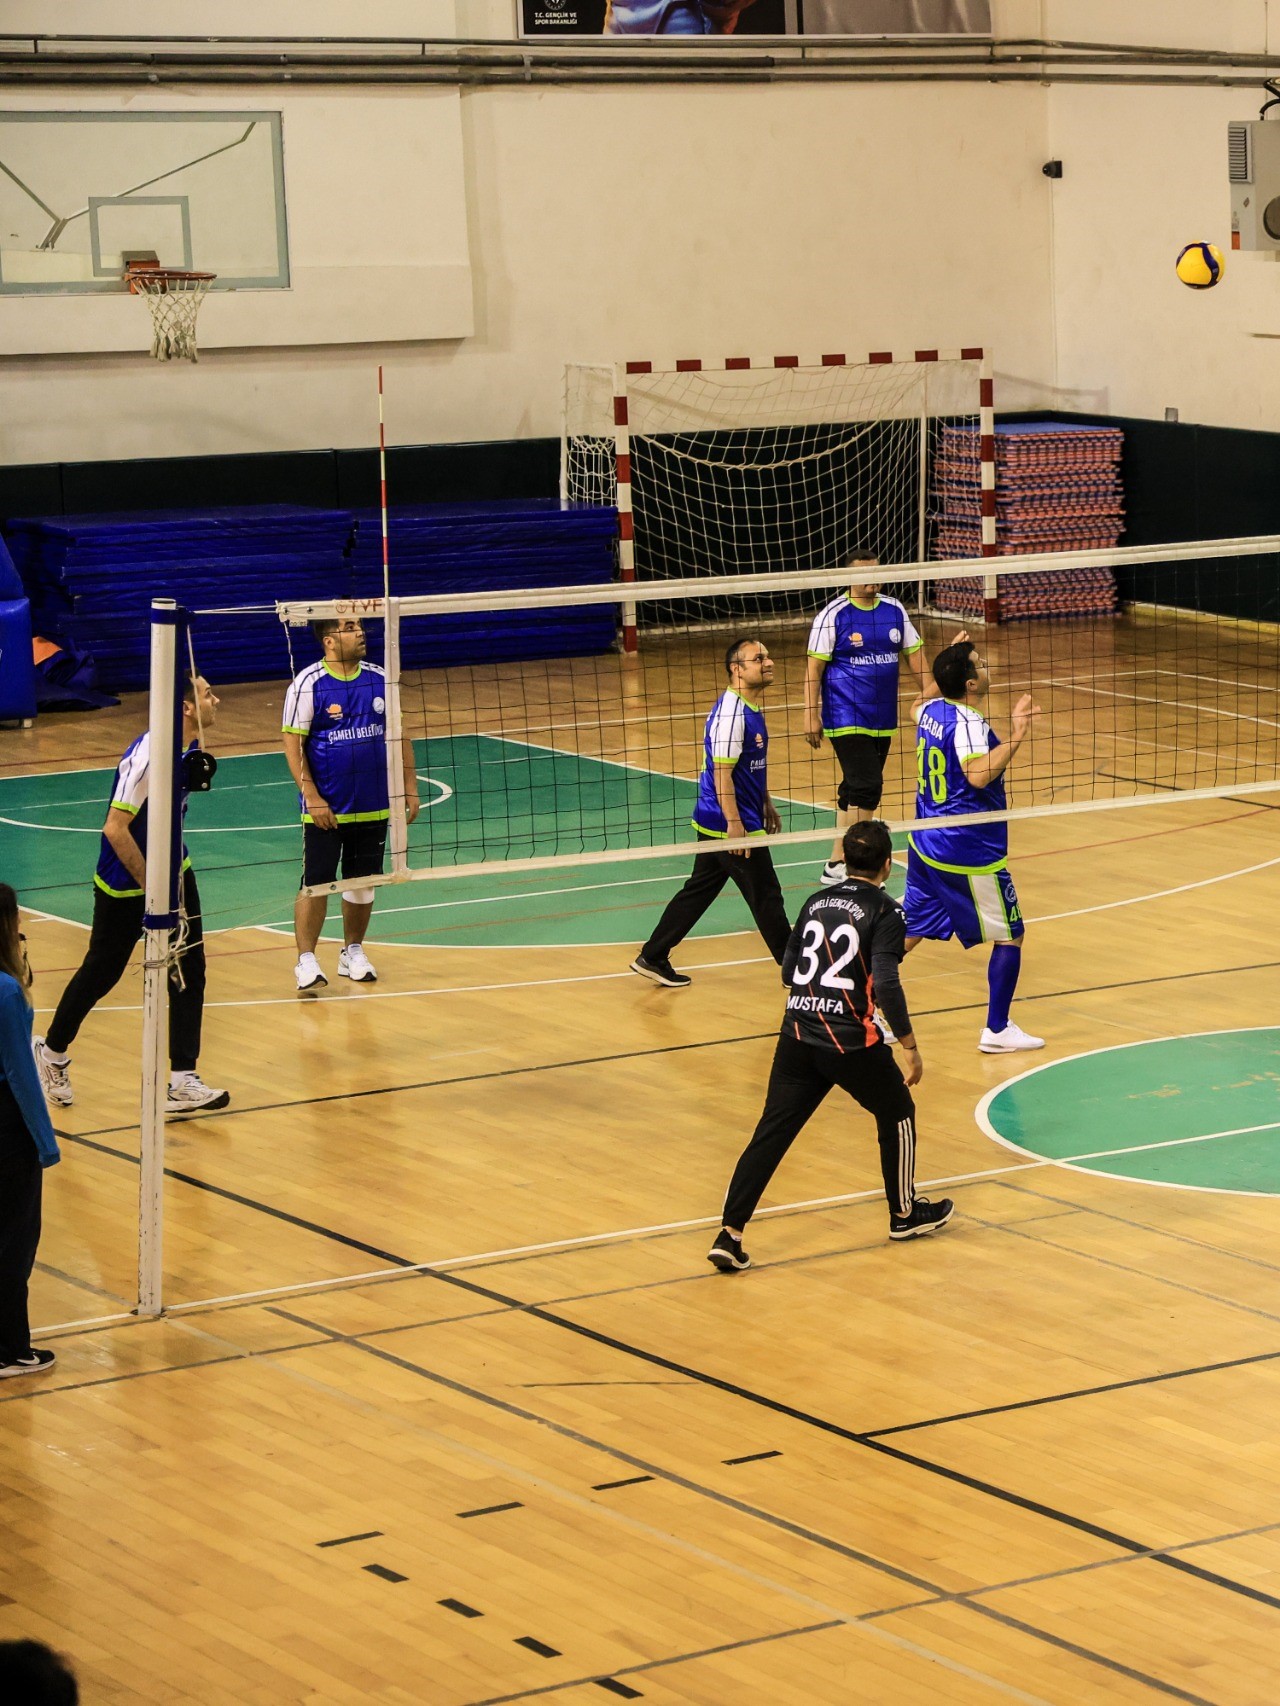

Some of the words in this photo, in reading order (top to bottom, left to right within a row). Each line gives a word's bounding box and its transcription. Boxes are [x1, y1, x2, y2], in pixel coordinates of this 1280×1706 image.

[545, 11, 569, 19] GENÇLİK
[348, 598, 382, 613] TVF
[328, 726, 355, 745] ÇAMELİ
[920, 713, 944, 740] BABA
[916, 737, 948, 804] 48
[808, 896, 829, 916] ÇAMELİ
[828, 898, 851, 911] GENÇLİK
[848, 902, 866, 921] SPOR
[792, 920, 860, 991] 32
[786, 995, 844, 1015] MUSTAFA
